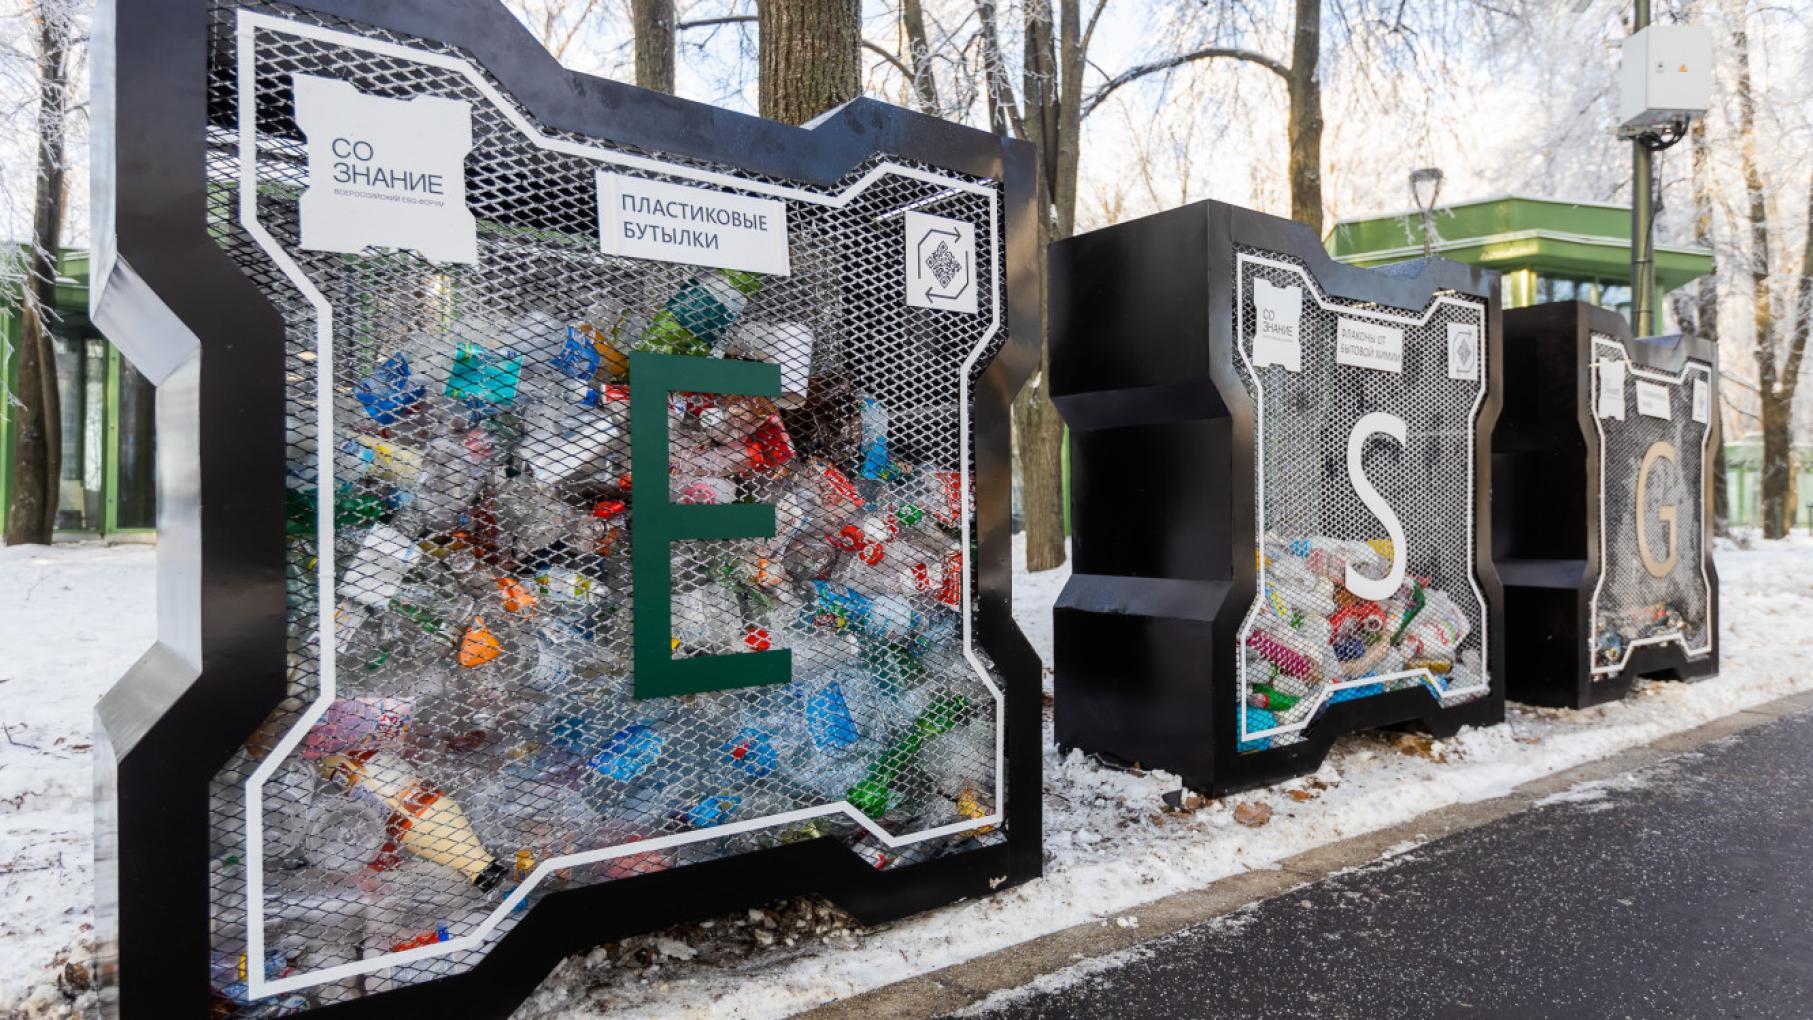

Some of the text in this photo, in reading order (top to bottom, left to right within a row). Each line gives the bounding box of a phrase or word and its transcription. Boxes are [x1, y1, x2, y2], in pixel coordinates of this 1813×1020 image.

[331, 138, 374, 161] СО
[333, 162, 444, 195] ЗНАНИЕ
[621, 193, 768, 232] ПЛАСТИКОВЫЕ
[623, 221, 719, 250] БУТЫЛКИ
[1263, 321, 1293, 337] ЗНАНИЕ
[1345, 411, 1407, 600] S
[1636, 441, 1677, 578] G
[629, 351, 793, 700] E
